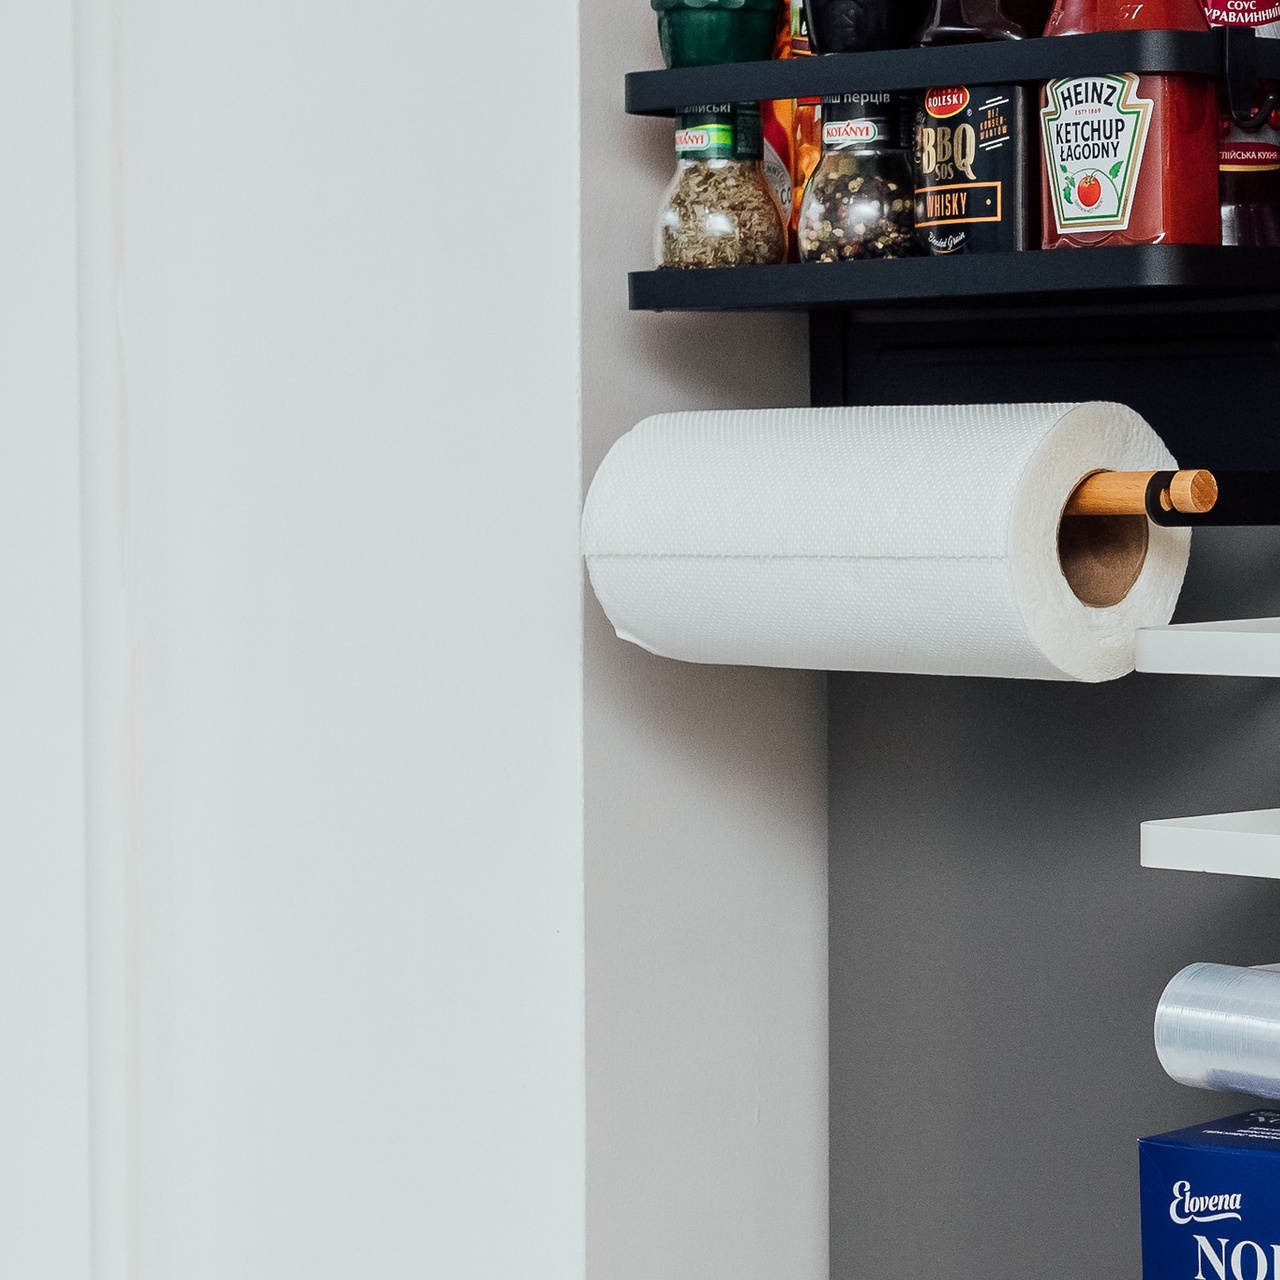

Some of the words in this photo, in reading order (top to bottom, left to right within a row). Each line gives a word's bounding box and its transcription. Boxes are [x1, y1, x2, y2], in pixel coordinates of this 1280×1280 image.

[1204, 2, 1280, 23] УРАВЛИННИЙ
[1227, 0, 1257, 11] СОУС
[928, 93, 963, 108] ROLESKI
[1061, 81, 1117, 110] HEINZ
[826, 122, 870, 138] KOTÁNYI
[1056, 118, 1125, 145] KETCHUP
[922, 123, 976, 180] BBQ
[1060, 141, 1120, 162] ŁAGODNY
[935, 163, 954, 180] SOS
[926, 192, 967, 217] WHISKY
[1170, 1180, 1242, 1224] Elovena
